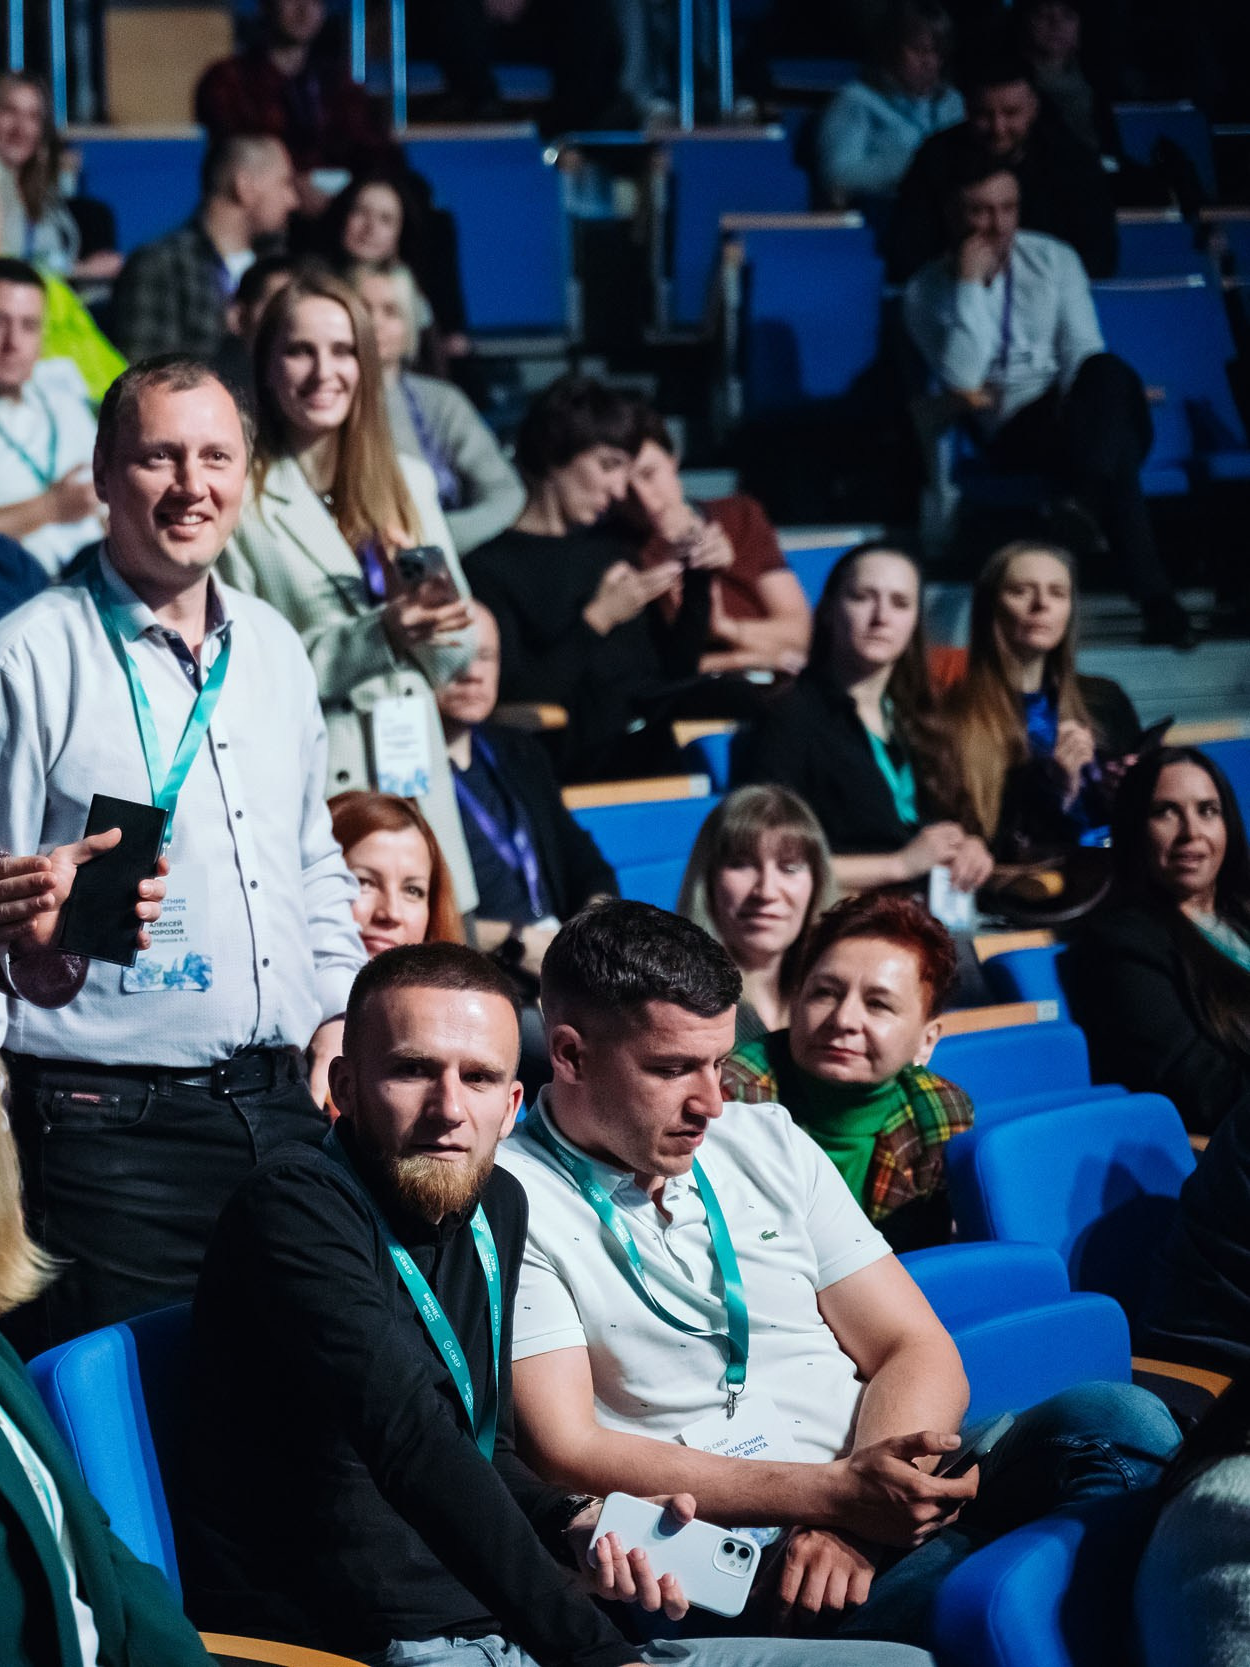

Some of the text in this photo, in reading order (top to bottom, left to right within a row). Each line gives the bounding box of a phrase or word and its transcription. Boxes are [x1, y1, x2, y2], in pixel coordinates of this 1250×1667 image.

[150, 919, 183, 928] АЛЕКСЕЙ
[588, 1186, 603, 1203] СБЕР
[399, 1256, 413, 1276] СБЕР
[483, 1253, 495, 1282] БИЗНЕС
[488, 1253, 497, 1273] ФЕСТ
[422, 1304, 435, 1323] ФЕСТ
[423, 1292, 441, 1320] БИЗНЕС
[449, 1349, 461, 1368] СБЕР
[712, 1437, 729, 1450] СБЕР
[723, 1434, 765, 1457] УЧАСТНИК
[743, 1441, 769, 1457] ФЕСТА
